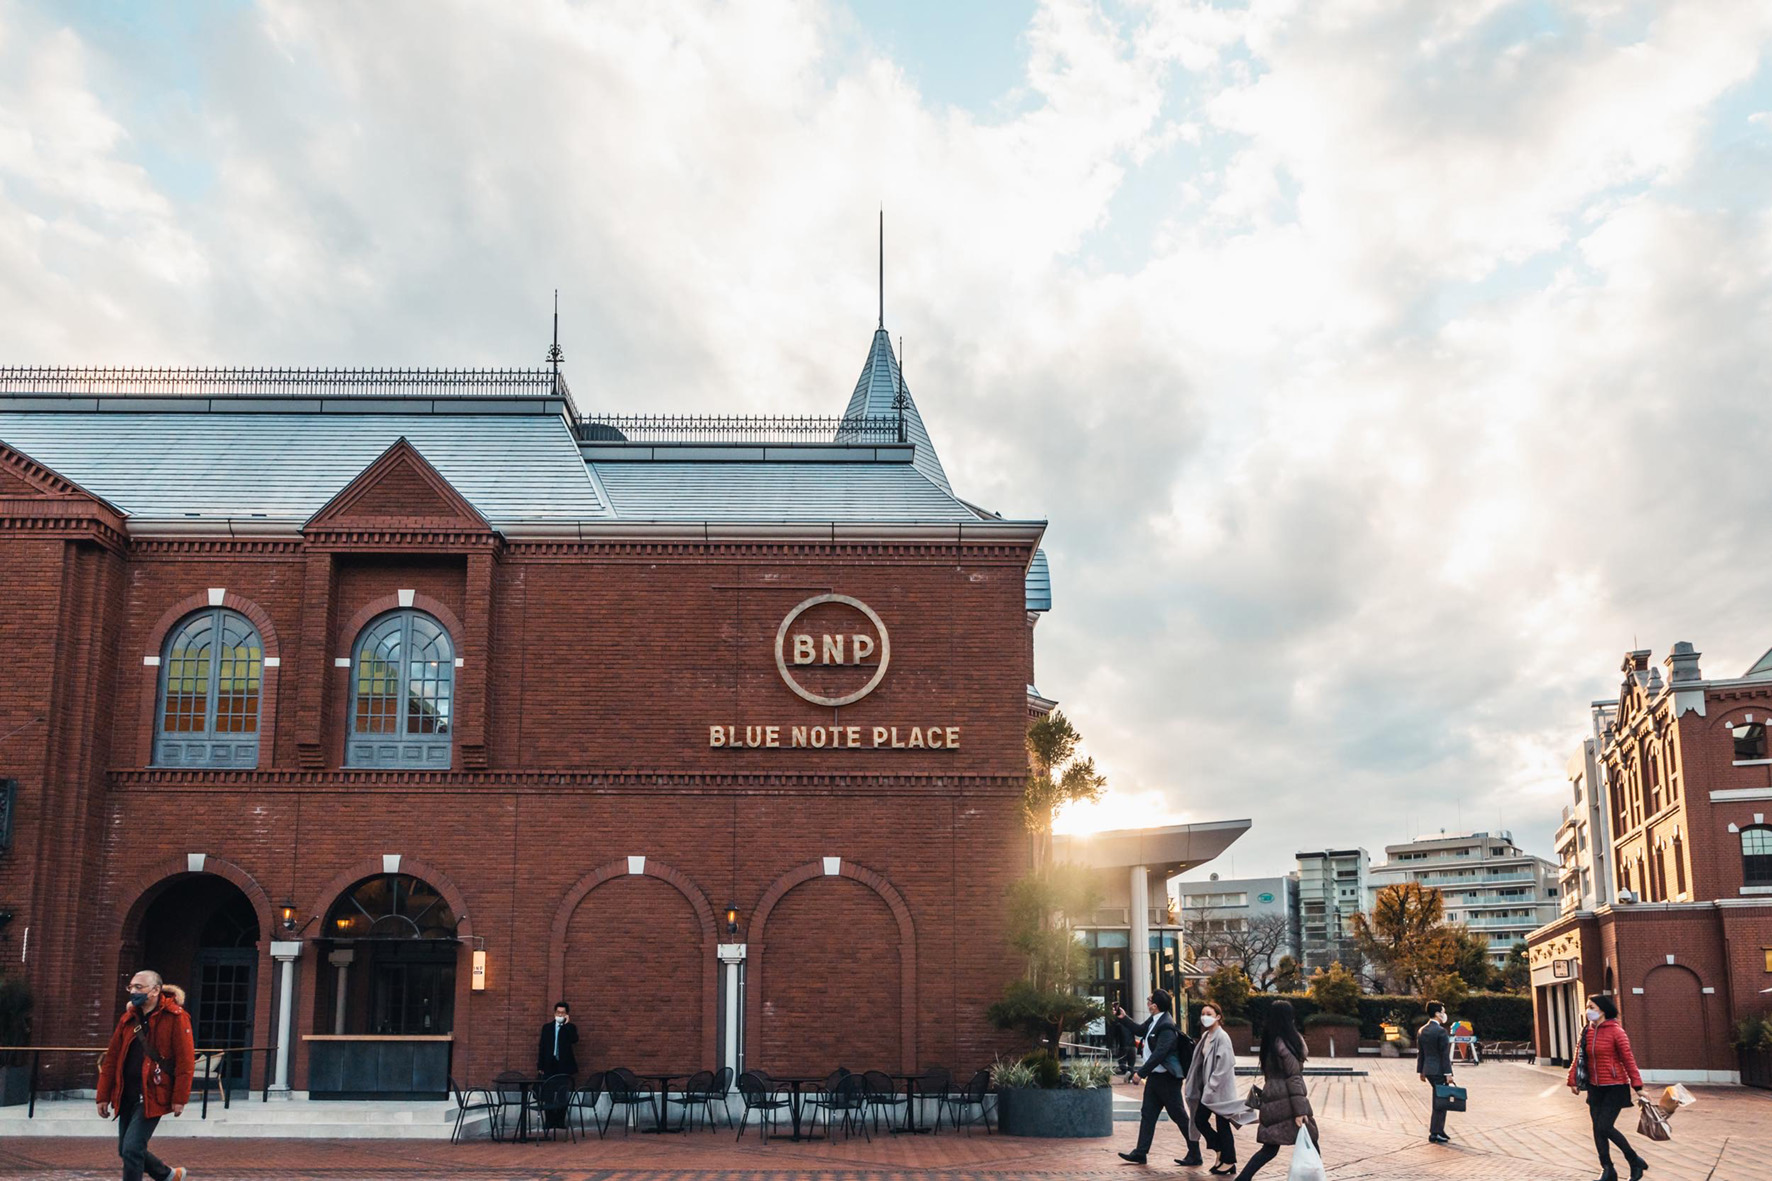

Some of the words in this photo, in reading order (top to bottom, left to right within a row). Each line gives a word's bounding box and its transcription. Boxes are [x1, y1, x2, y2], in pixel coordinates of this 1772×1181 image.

[793, 634, 875, 665] BNP
[709, 725, 780, 748] BLUE
[791, 726, 861, 749] NOTE
[873, 726, 960, 749] PLACE
